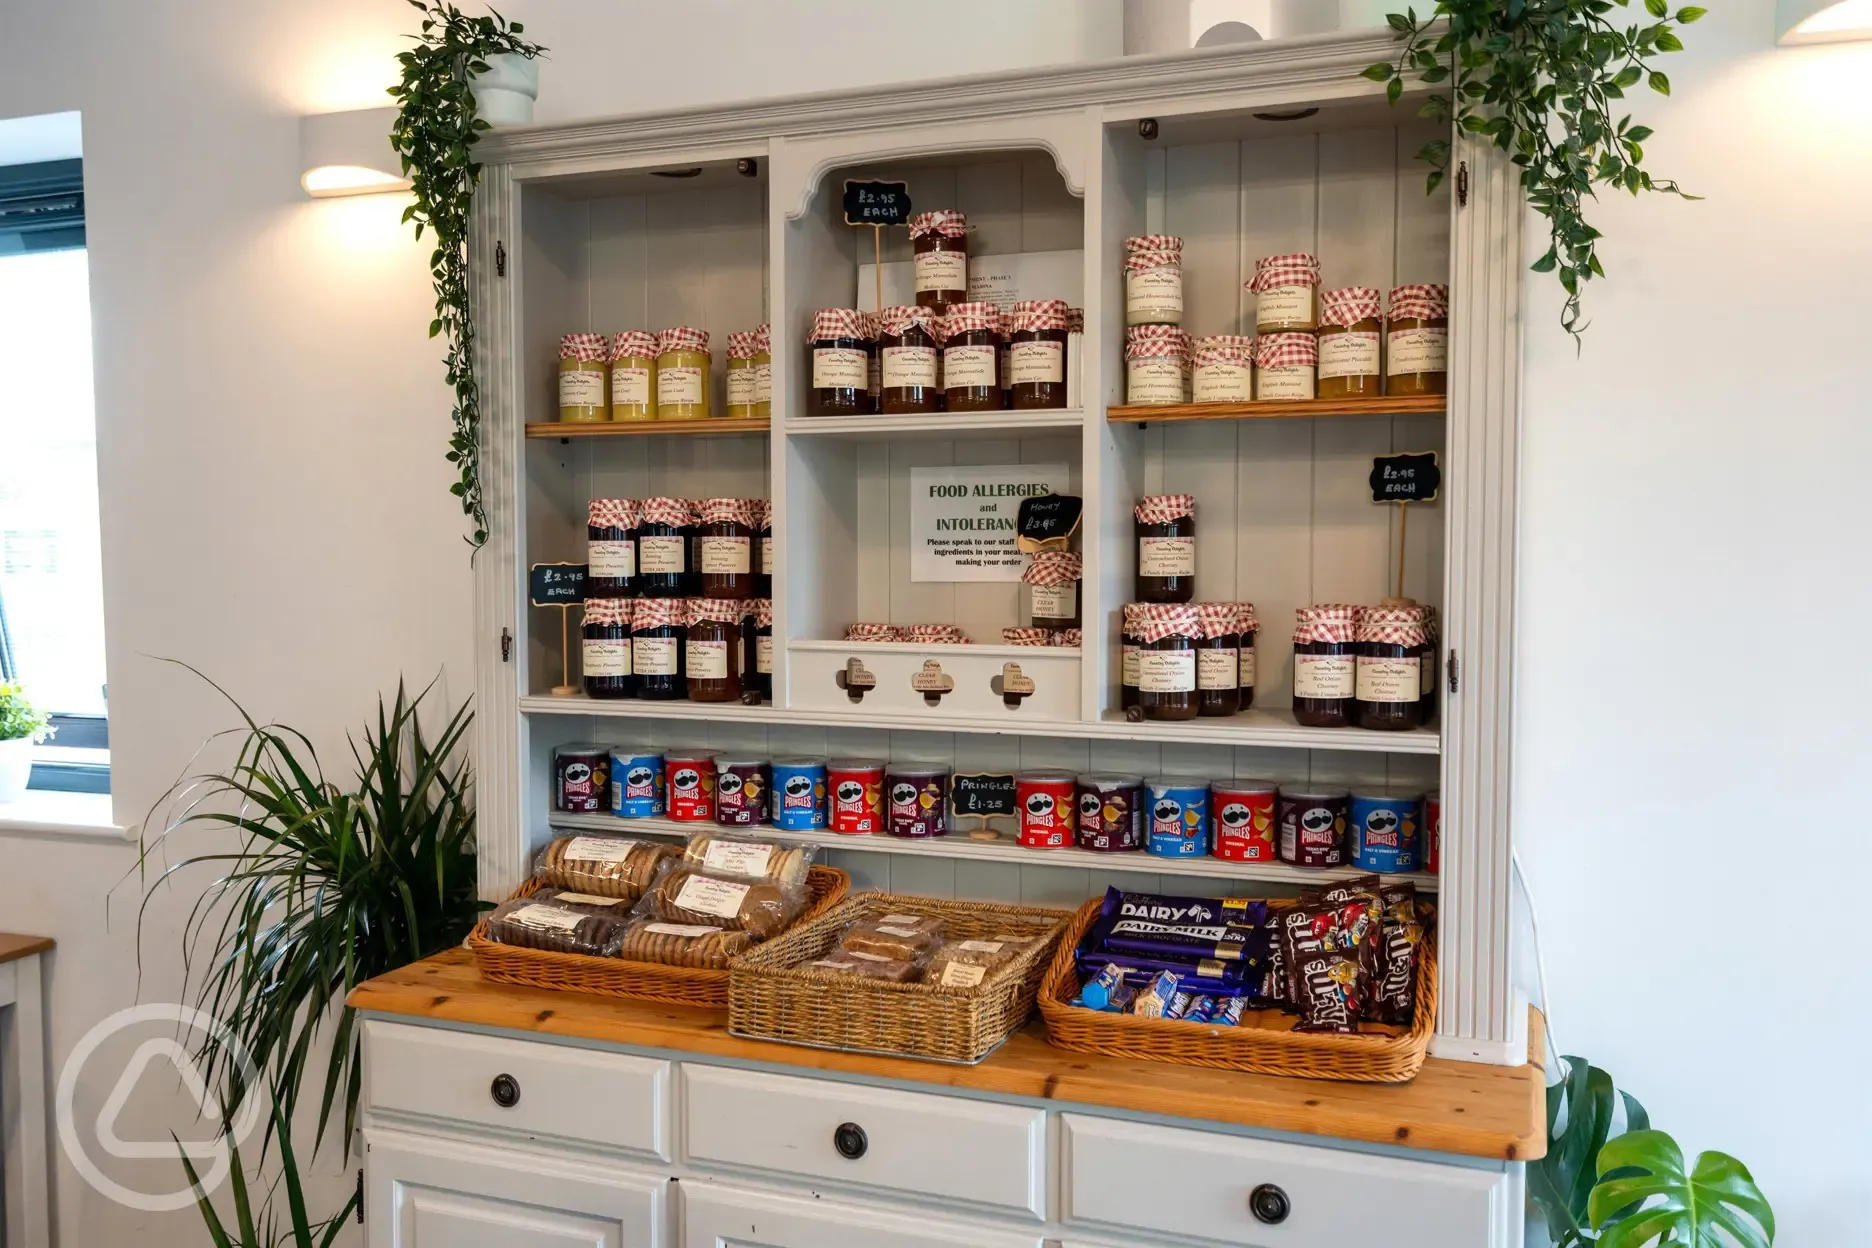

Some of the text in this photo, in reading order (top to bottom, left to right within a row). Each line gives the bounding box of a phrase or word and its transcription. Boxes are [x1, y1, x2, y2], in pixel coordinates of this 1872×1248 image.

[859, 189, 896, 204] £2.95
[863, 207, 898, 217] EACH
[1384, 465, 1415, 479] £2.95
[930, 483, 1049, 498] FOOD ALLERGIES
[1385, 483, 1415, 492] EACH
[980, 504, 997, 512] and
[1031, 502, 1060, 511] HONEY
[1026, 518, 1057, 531] £3.95
[927, 538, 950, 546] Please
[952, 539, 972, 547] speak
[998, 538, 1015, 546] staff
[934, 548, 974, 557] ingredients
[975, 548, 983, 556] in
[984, 549, 1000, 557] your
[955, 558, 1022, 567] making your order
[544, 569, 583, 583] £2.95
[547, 588, 575, 596] EACH
[566, 781, 590, 793] PRINGLES
[627, 785, 653, 798] PRINGLES
[674, 788, 699, 800] PRINGLES
[719, 792, 741, 805] PRINGLES
[785, 795, 811, 808] PRINGLES
[837, 801, 862, 813] PRINGLES
[968, 793, 1003, 809] £1.25
[893, 804, 917, 816] PRINGLES
[1027, 814, 1053, 828] PRINGLES
[1154, 820, 1180, 835] PRINGLES
[1222, 825, 1250, 840] PRINGLES
[1302, 829, 1332, 844] PRINGLES
[1366, 830, 1397, 847] PRINGLES
[1120, 903, 1188, 920] DAIRY
[1120, 922, 1219, 937] DAIRY MILK
